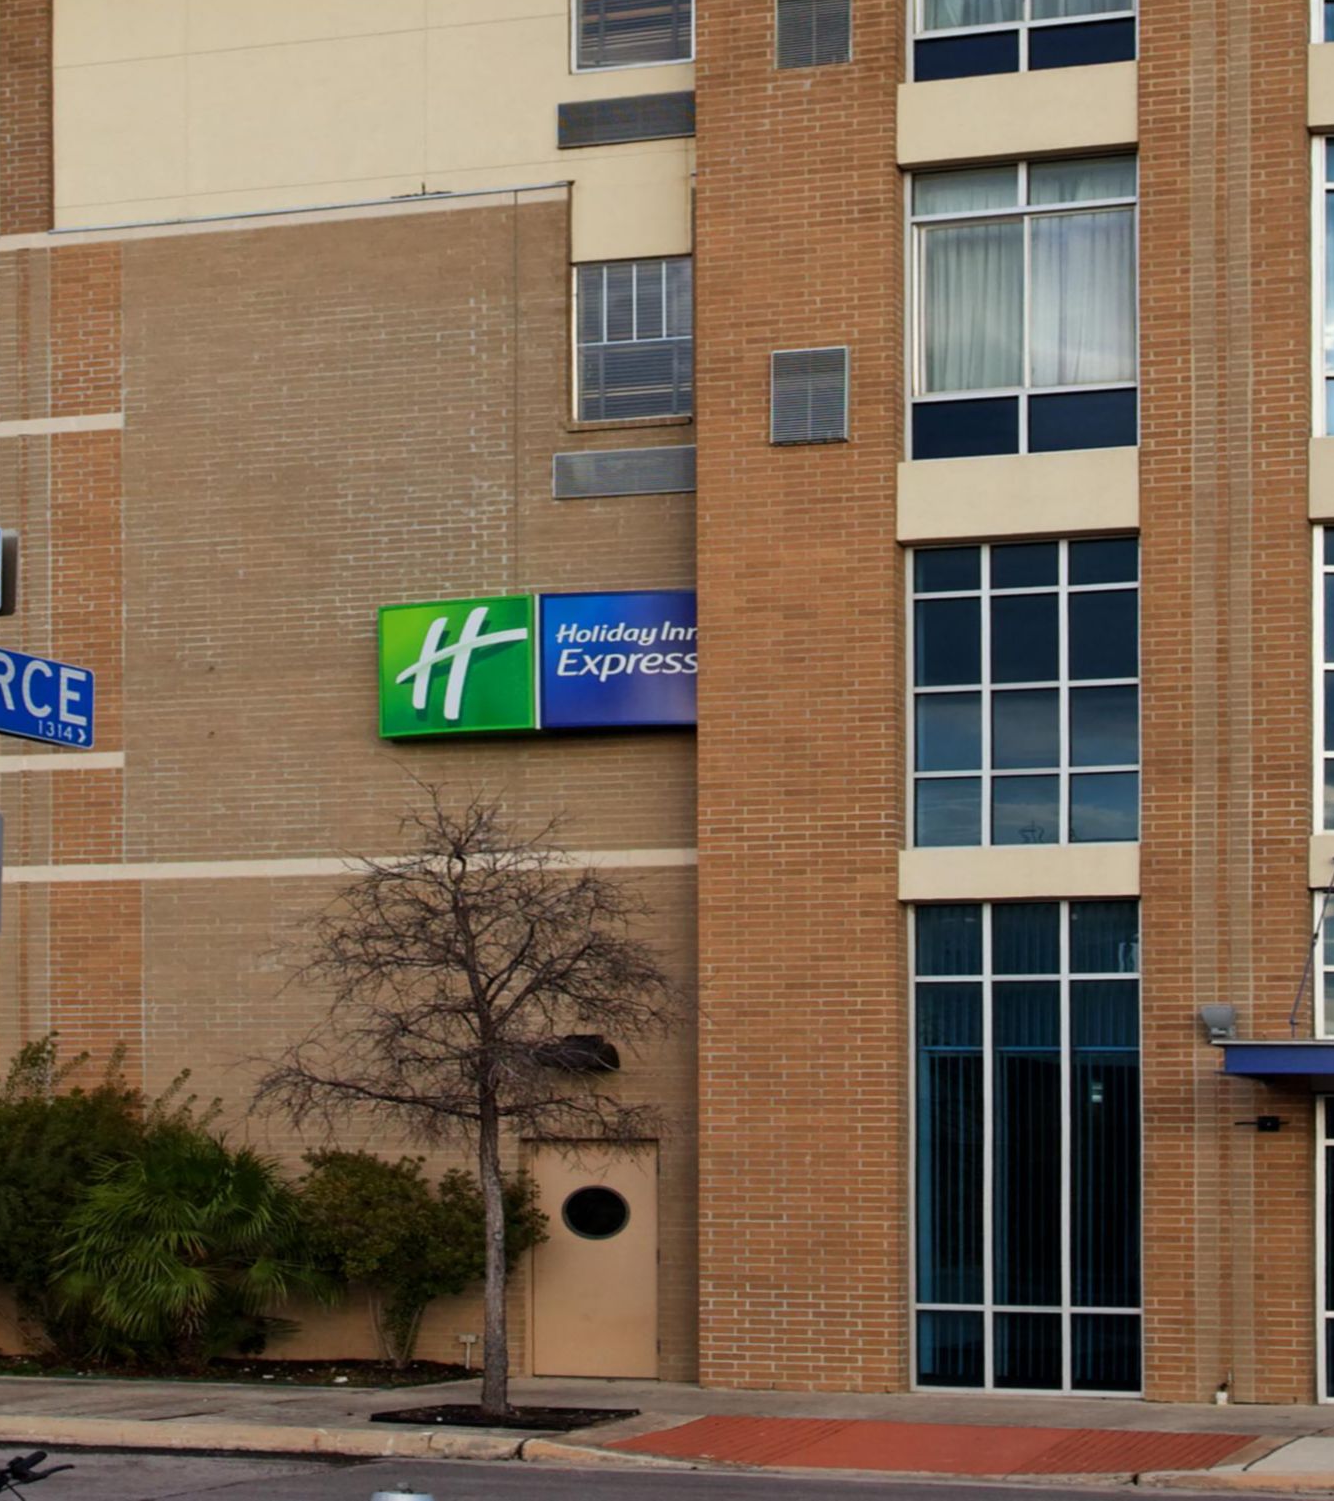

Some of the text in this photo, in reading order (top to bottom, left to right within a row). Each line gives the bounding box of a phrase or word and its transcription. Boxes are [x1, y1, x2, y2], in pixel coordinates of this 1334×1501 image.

[556, 622, 658, 646] Holiday
[557, 648, 698, 682] Express
[38, 720, 72, 740] 1314
